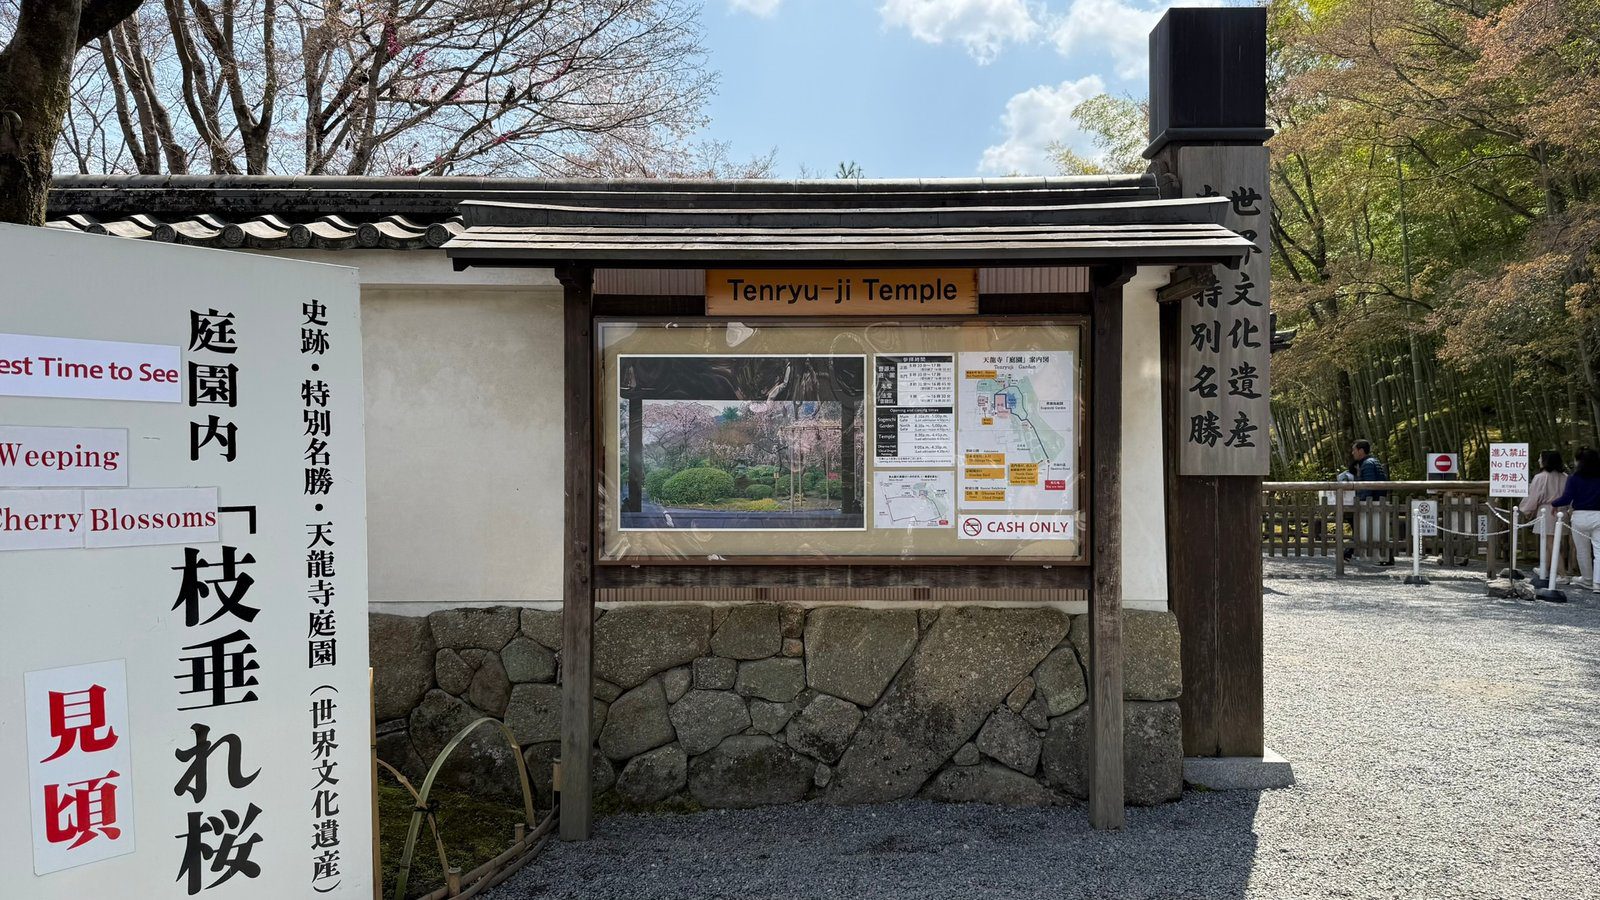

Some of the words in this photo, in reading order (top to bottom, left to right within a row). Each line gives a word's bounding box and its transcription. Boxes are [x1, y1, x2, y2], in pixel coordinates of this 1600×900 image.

[727, 278, 851, 304] Tenryu-ji
[862, 278, 958, 303] Temple
[1188, 185, 1223, 447] 特別名勝
[38, 357, 104, 379] Time
[108, 362, 133, 380] to
[139, 363, 179, 383] See
[188, 308, 239, 462] 庭園内
[0, 443, 120, 471] Weeping
[1491, 448, 1527, 457] 進入禁止
[1505, 461, 1527, 470] Entry
[0, 507, 83, 532] herry
[90, 508, 217, 531] Blossoms
[987, 522, 1024, 533] CASH
[1030, 521, 1069, 533] ONLY
[40, 684, 123, 851] 見頃
